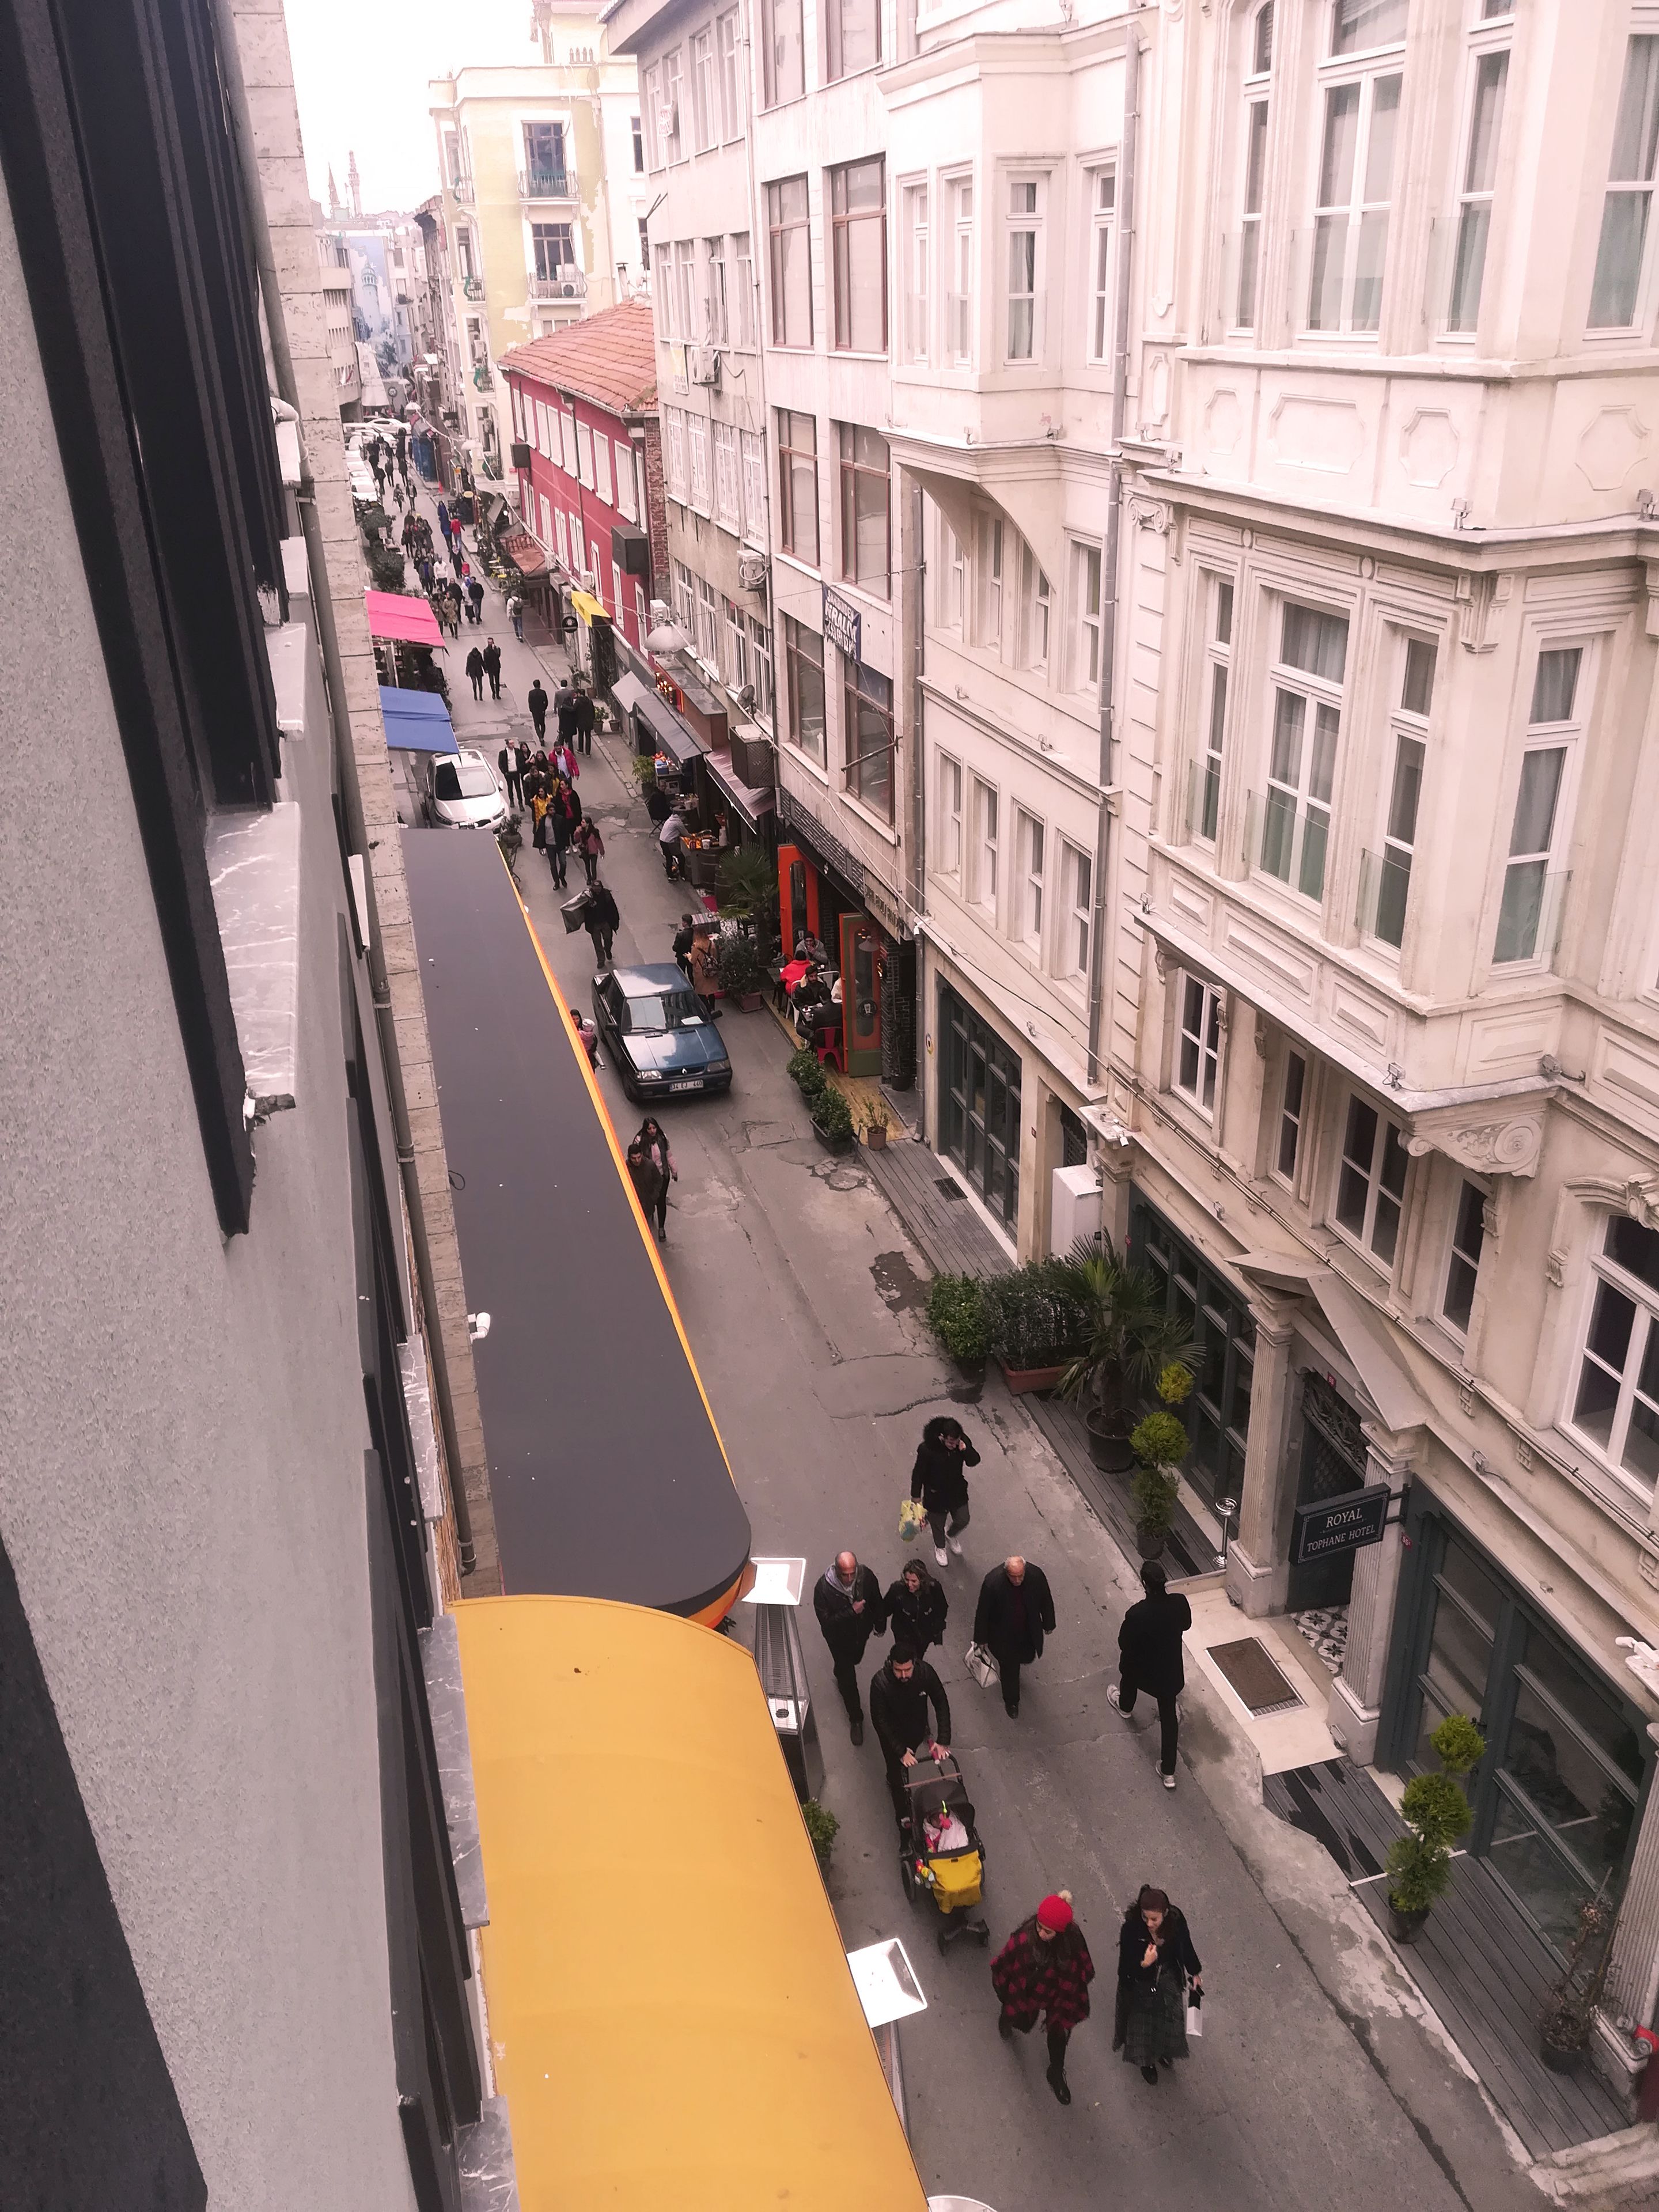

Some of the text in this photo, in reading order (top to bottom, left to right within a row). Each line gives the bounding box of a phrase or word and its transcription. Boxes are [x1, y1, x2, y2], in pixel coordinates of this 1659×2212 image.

[1326, 1508, 1362, 1528] ROYAL
[1307, 1524, 1376, 1552] TOPHANE HOTEL
